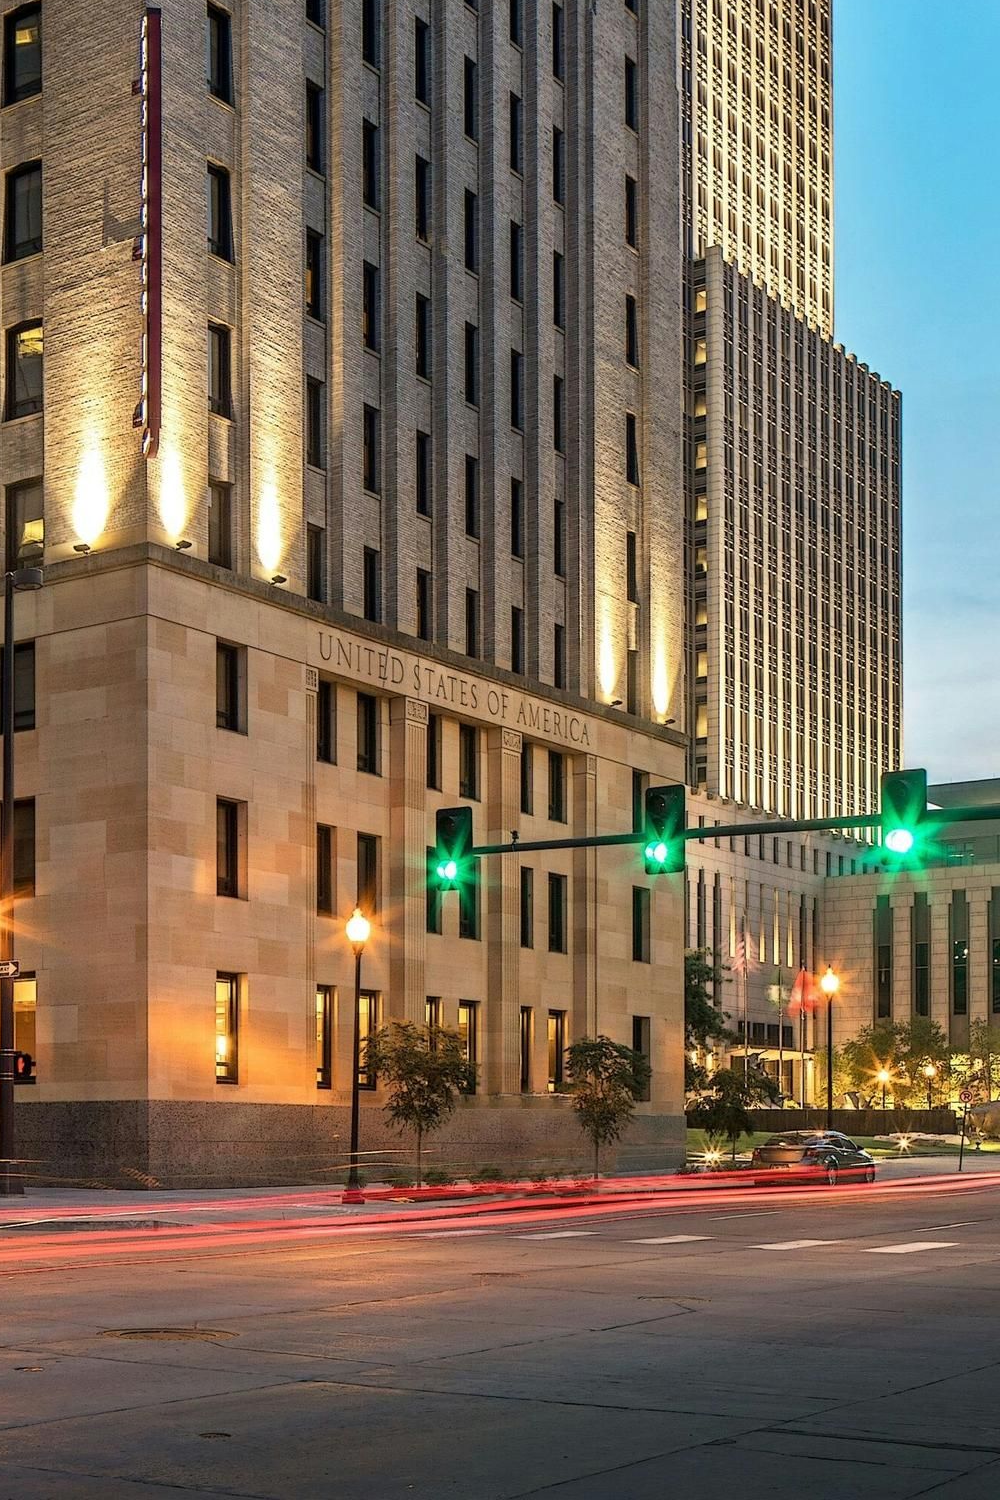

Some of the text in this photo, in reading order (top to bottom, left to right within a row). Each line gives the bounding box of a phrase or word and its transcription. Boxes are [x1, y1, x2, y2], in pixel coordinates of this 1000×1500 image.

[318, 631, 591, 746] UNITED STATES OF AMERICA
